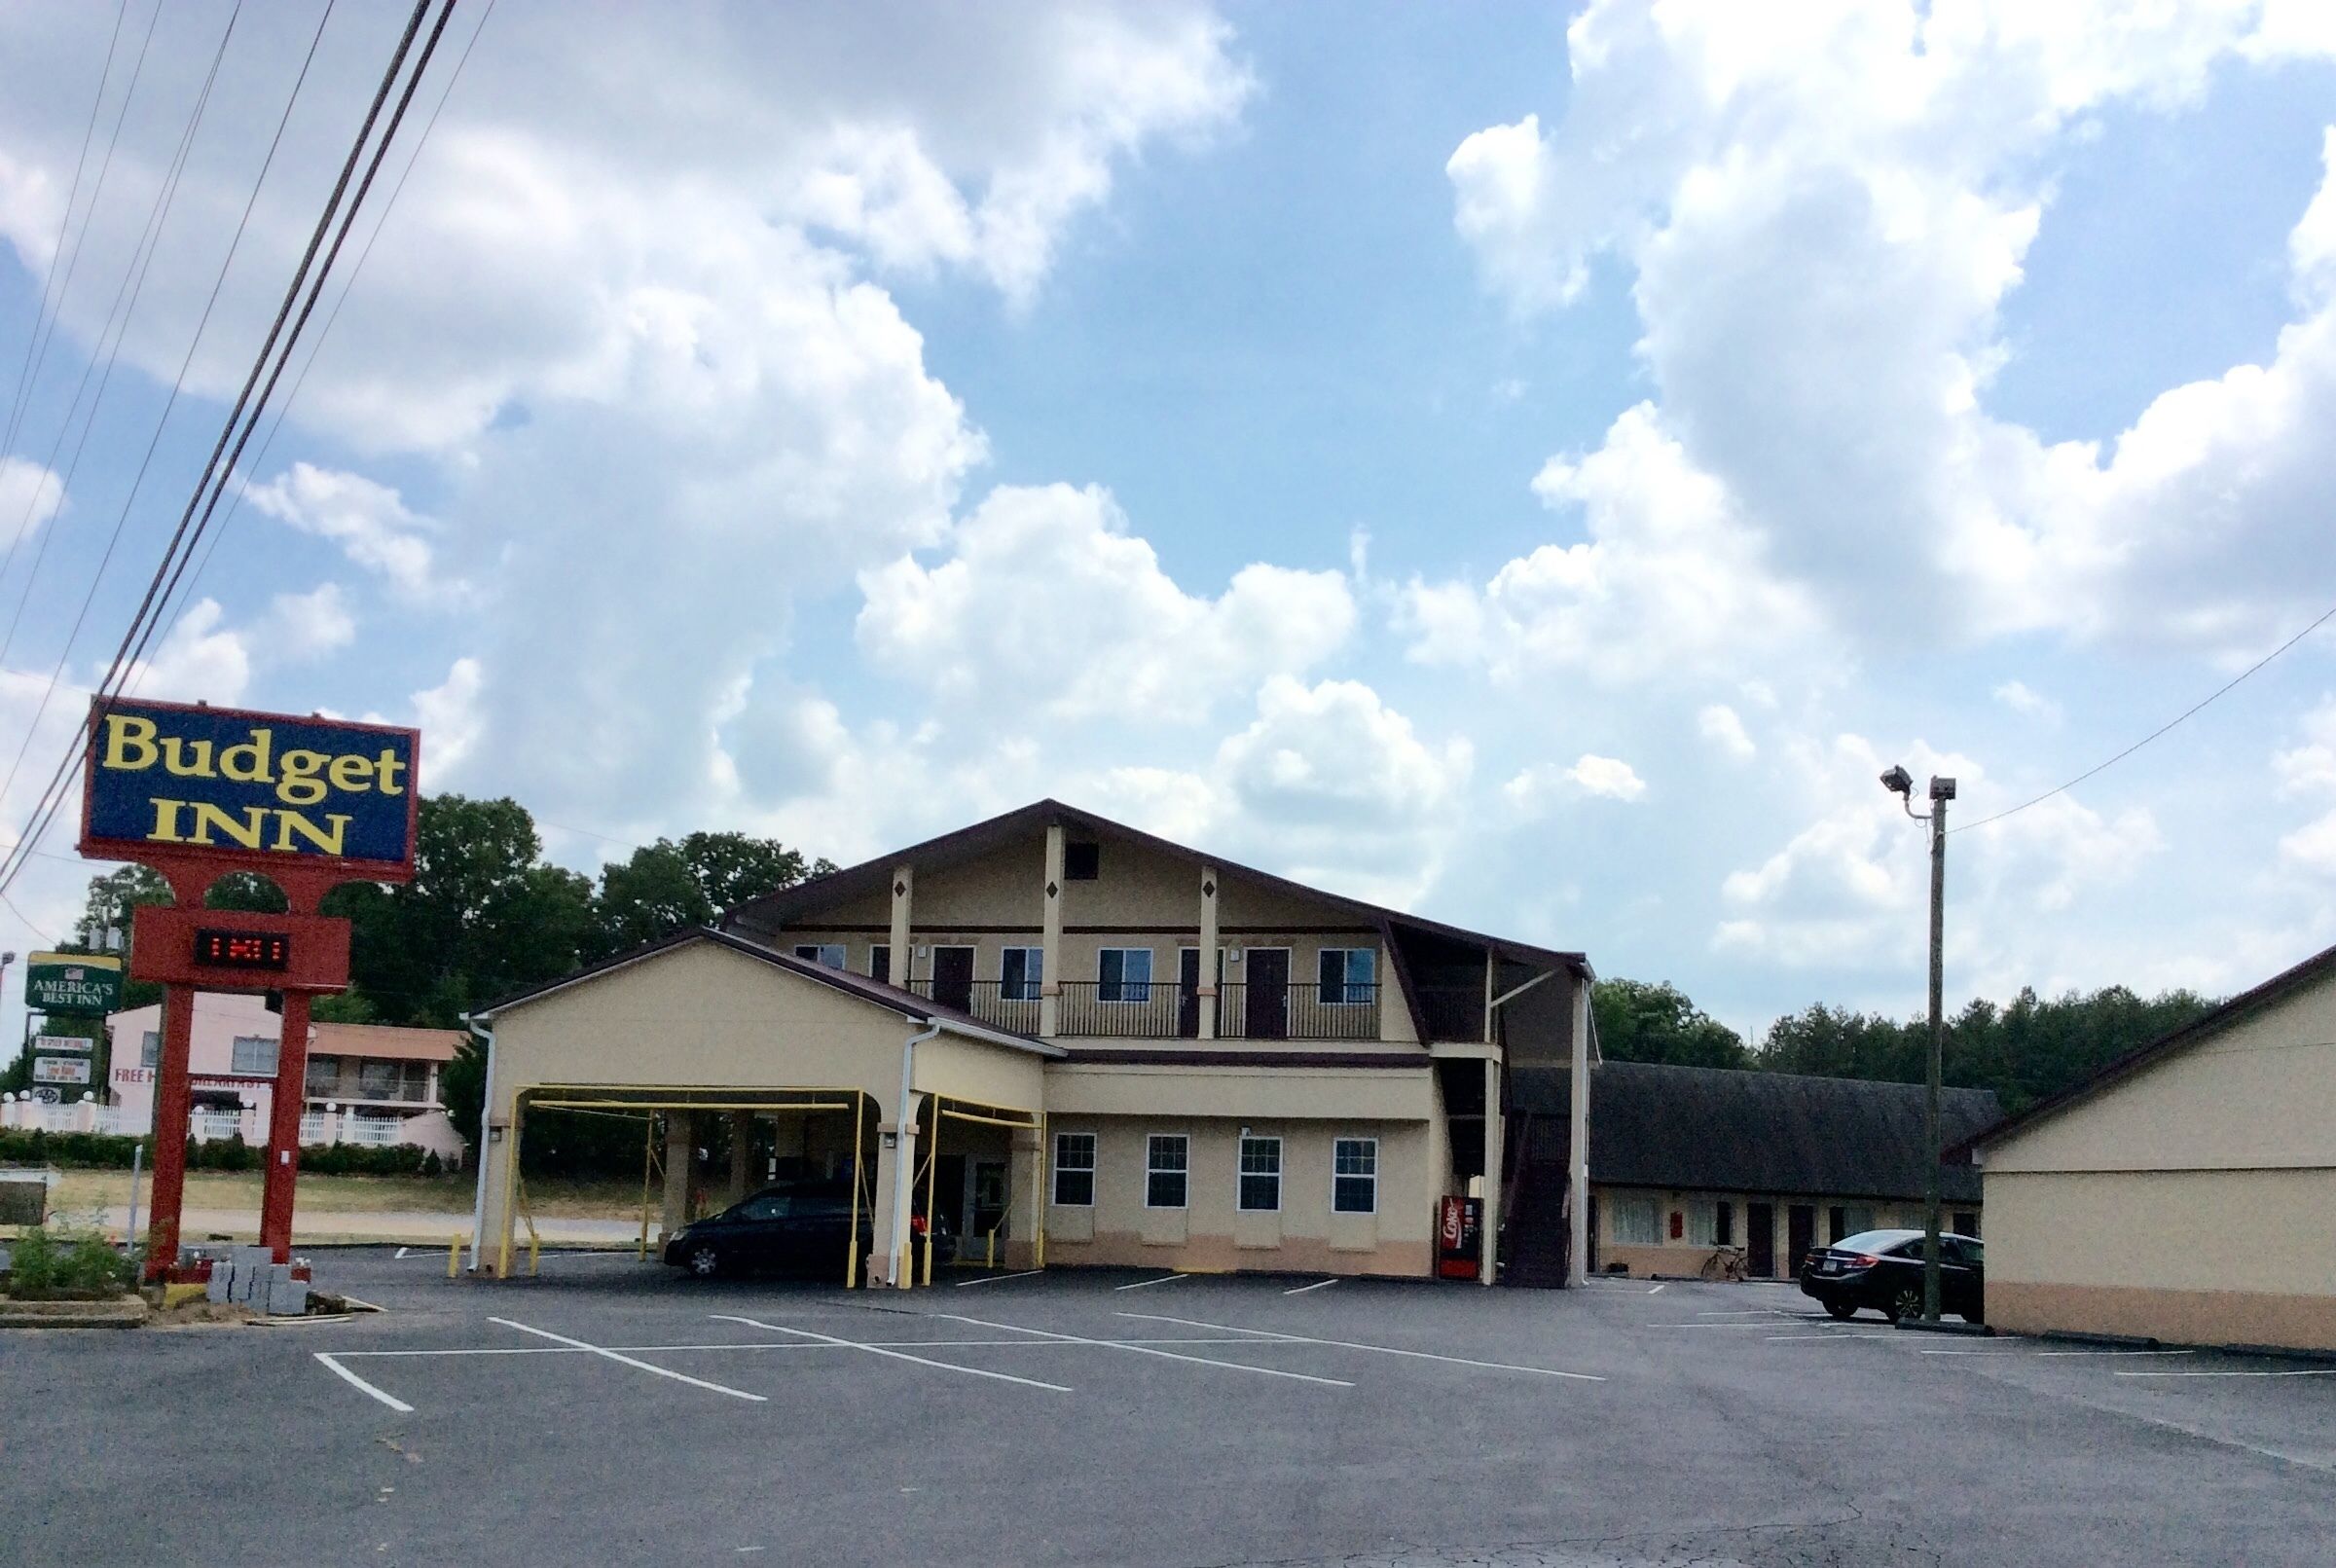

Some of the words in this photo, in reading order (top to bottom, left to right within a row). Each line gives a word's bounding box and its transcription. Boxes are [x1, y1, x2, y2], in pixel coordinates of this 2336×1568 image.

[102, 713, 406, 805] Budget
[146, 797, 353, 856] INN
[34, 979, 113, 996] AMERICA'S
[42, 992, 74, 1004] BEST
[77, 994, 103, 1006] INN
[115, 1069, 144, 1082] FREE
